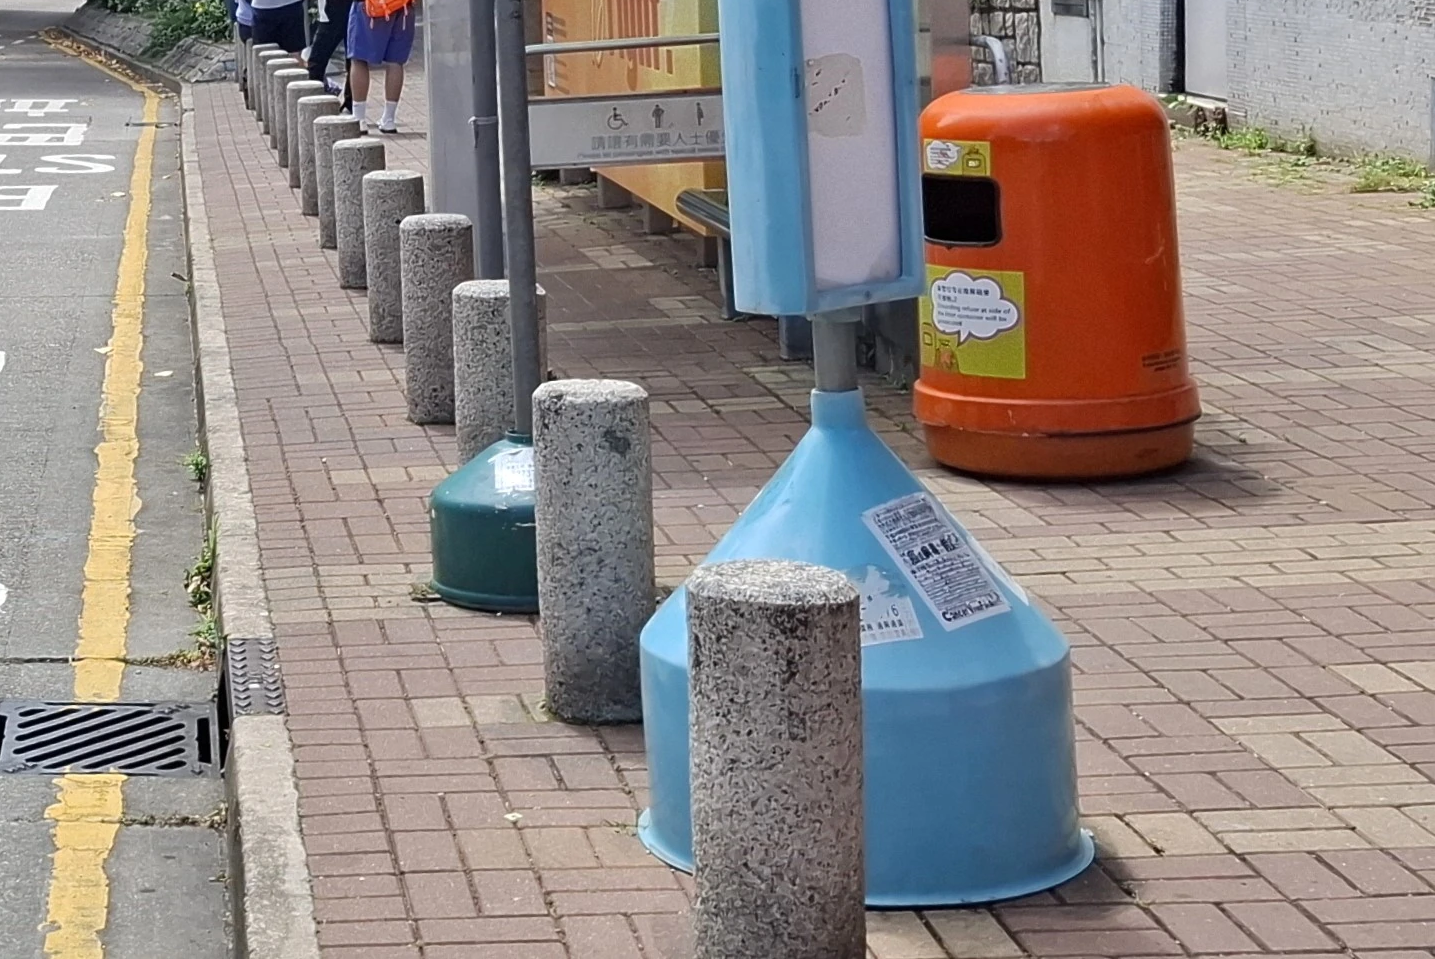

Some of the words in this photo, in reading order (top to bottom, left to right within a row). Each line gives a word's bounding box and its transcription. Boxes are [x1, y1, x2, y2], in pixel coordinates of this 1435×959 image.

[592, 130, 725, 150] 請讓有需要人士優
